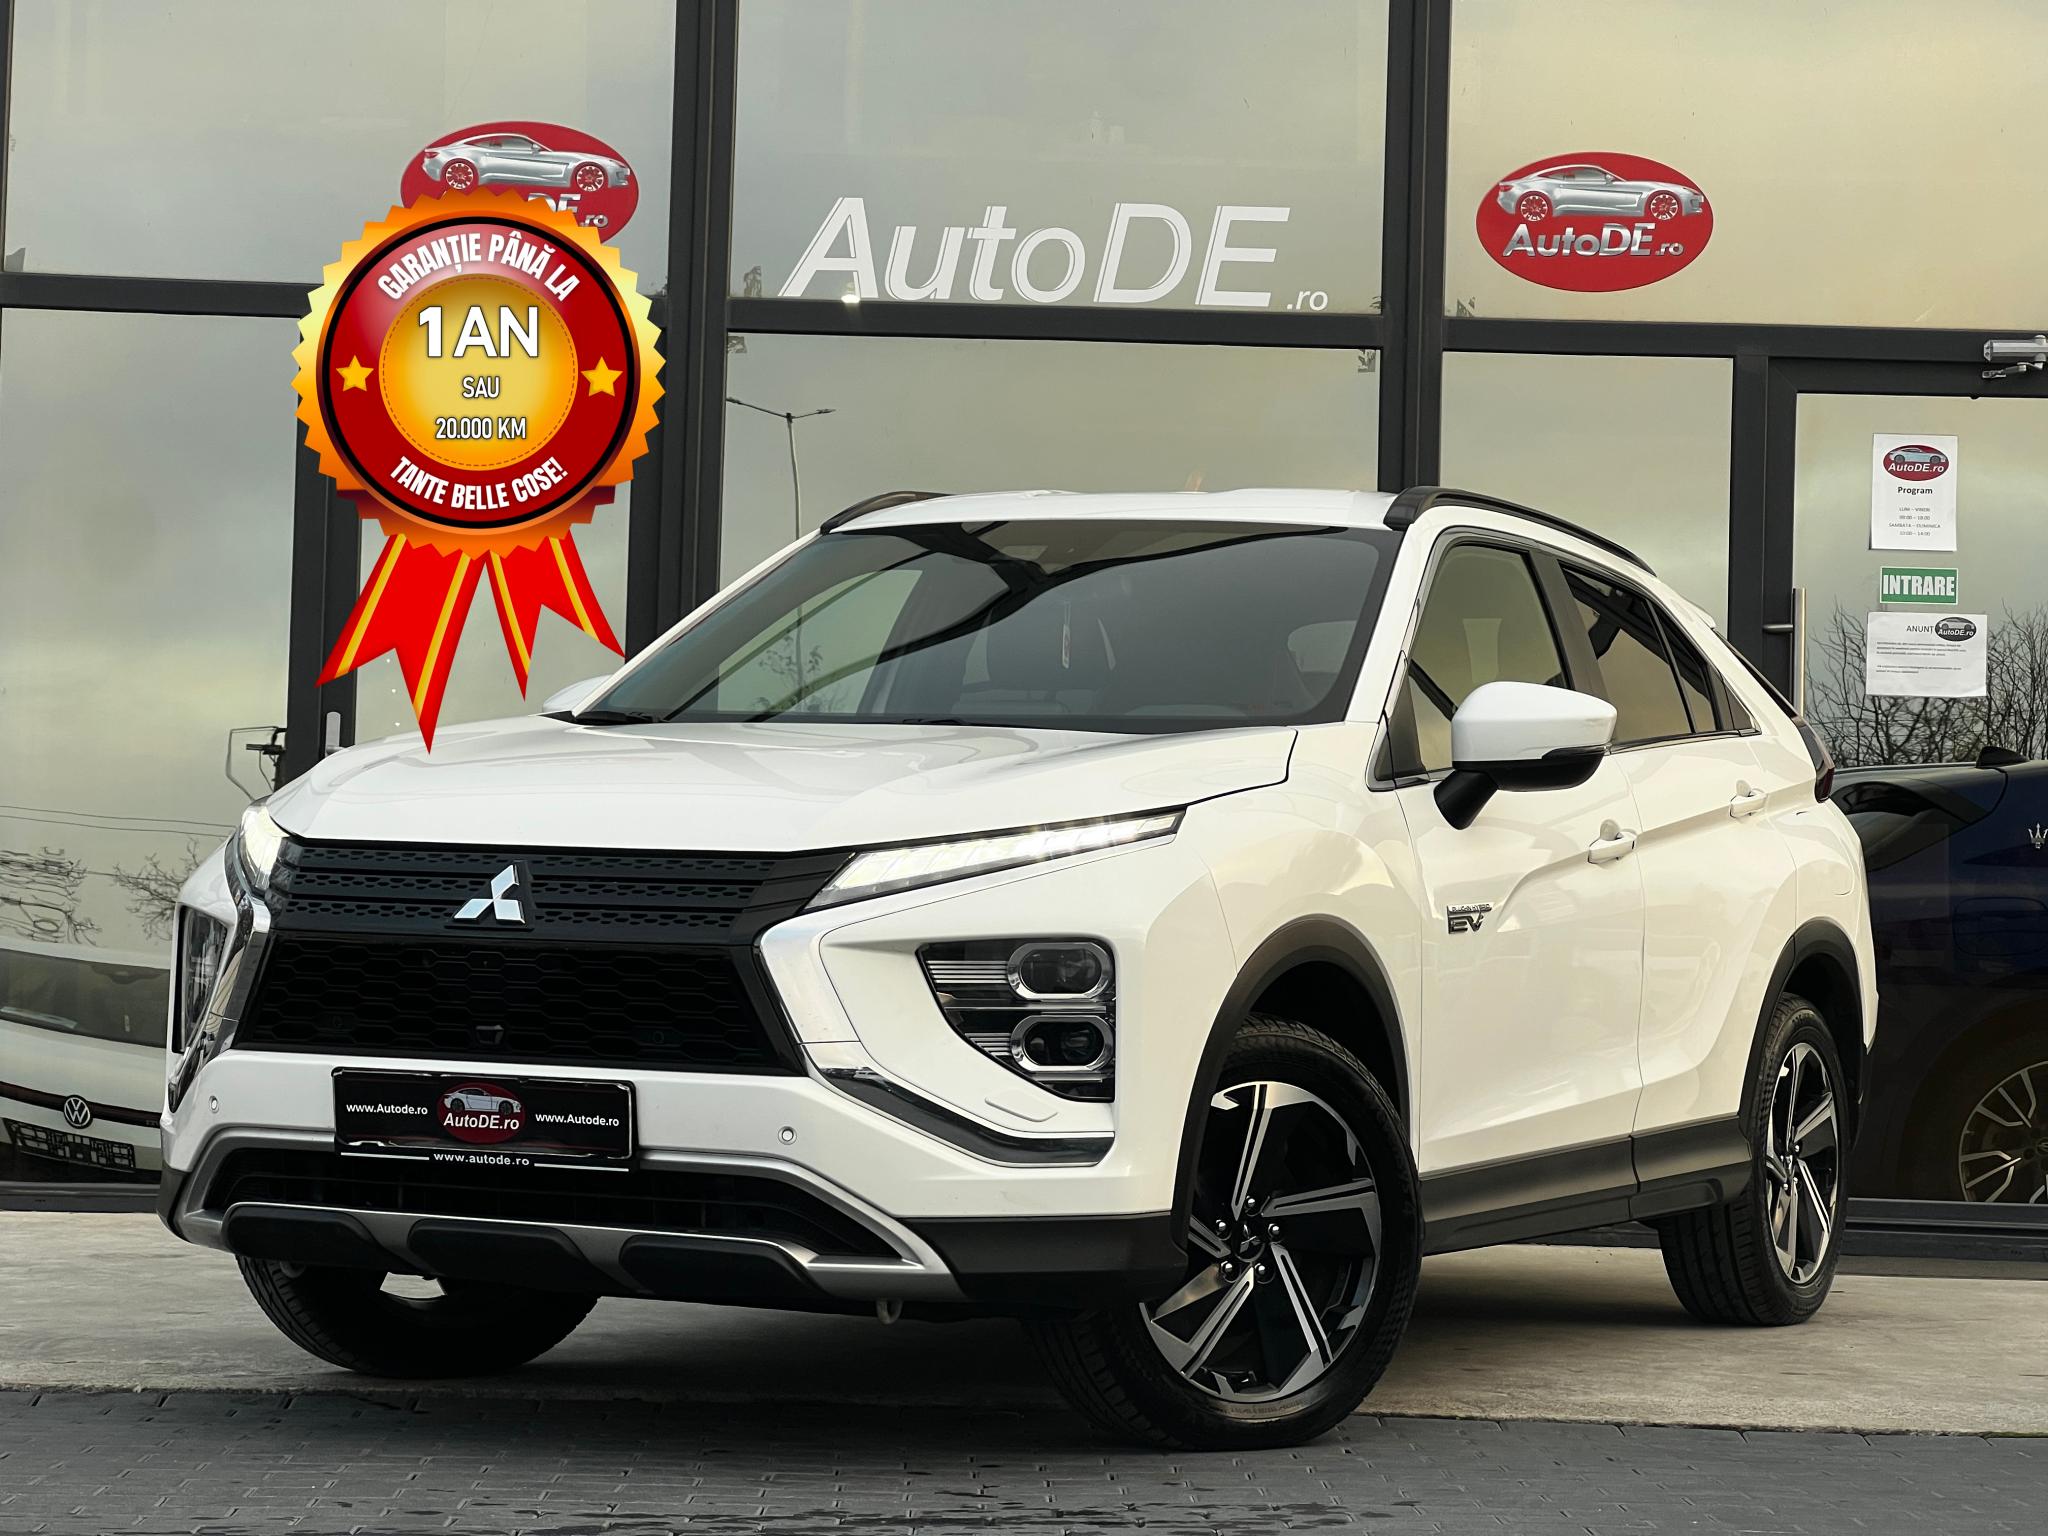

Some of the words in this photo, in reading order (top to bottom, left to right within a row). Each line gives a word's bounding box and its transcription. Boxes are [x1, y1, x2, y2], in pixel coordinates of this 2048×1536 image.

[1887, 463, 1945, 474] AutoDE.ro
[1897, 486, 1933, 496] Program
[1883, 575, 1955, 596] INTRARE
[346, 1102, 428, 1115] www.Autode.ro
[443, 1112, 520, 1131] AutoDE.ro
[535, 1112, 620, 1127] www.Autode.ro
[433, 1152, 530, 1166] www.autode.ro
